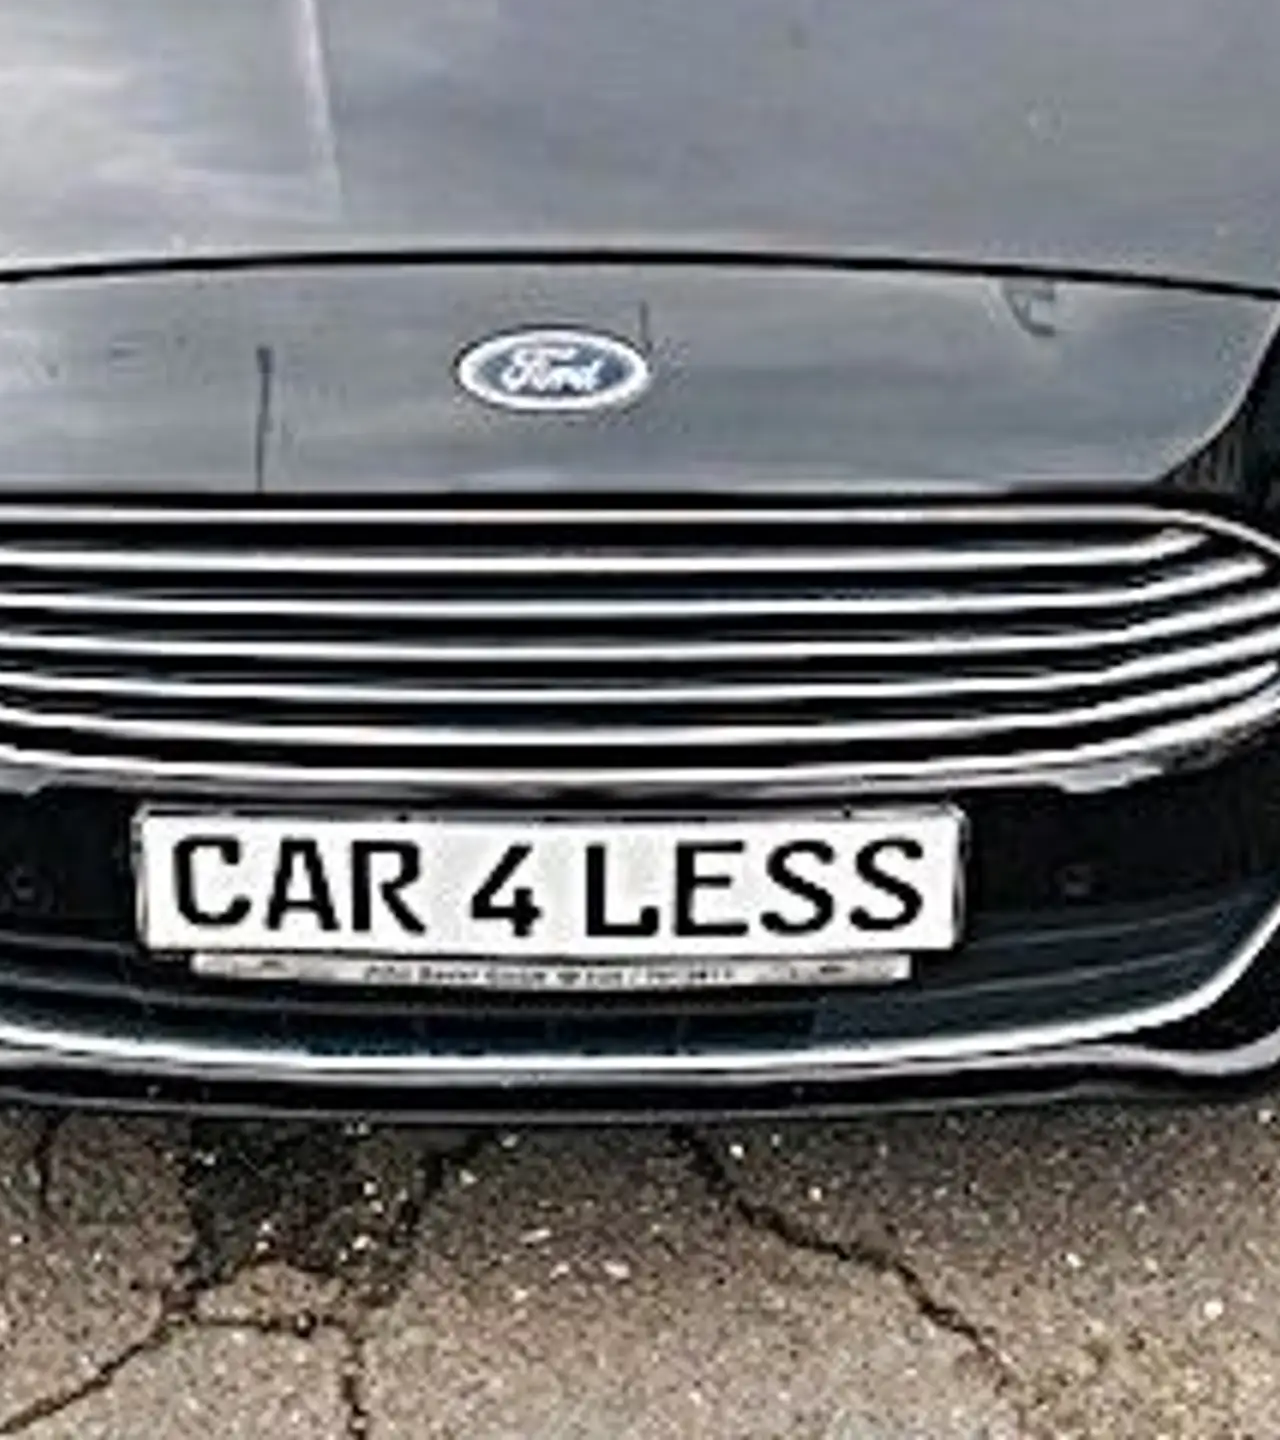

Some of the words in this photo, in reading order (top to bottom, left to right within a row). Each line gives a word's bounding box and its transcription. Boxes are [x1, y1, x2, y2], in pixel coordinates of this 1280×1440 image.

[501, 346, 604, 392] Ford
[173, 834, 425, 936] CAR
[470, 841, 541, 938] 4
[585, 835, 924, 938] LESS
